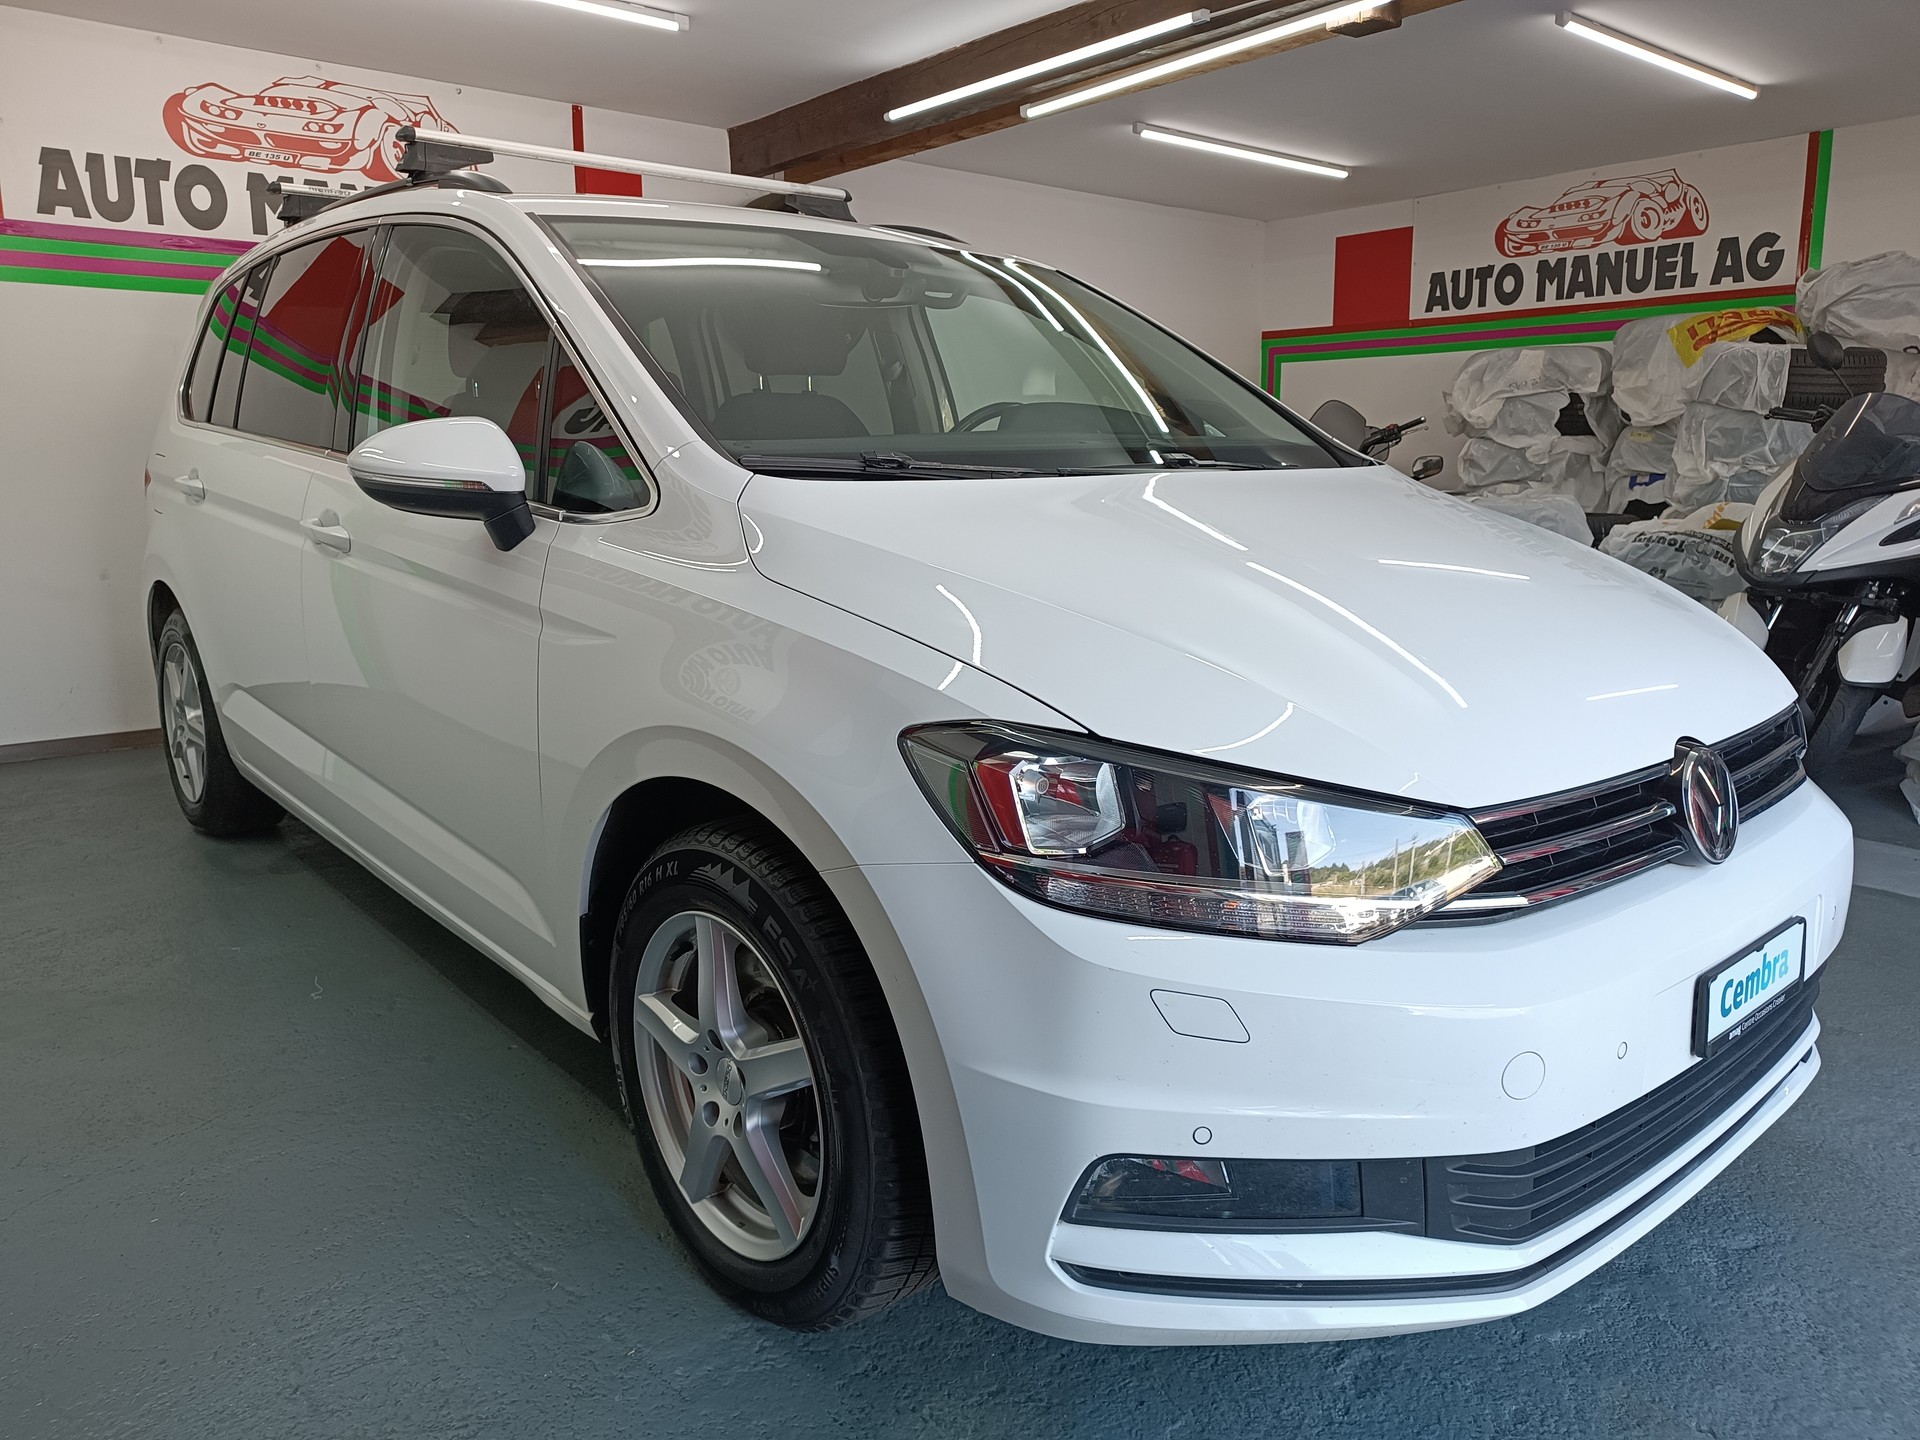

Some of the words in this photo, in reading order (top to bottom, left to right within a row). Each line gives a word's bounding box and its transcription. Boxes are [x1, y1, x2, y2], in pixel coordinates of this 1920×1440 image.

[36, 146, 228, 231] AUTO
[1424, 262, 1524, 314] AUTO
[1536, 242, 1699, 302] MANUEL
[1709, 231, 1785, 286] AG
[655, 865, 663, 882] H
[666, 860, 678, 878] XL
[1720, 949, 1789, 1018] Cembra
